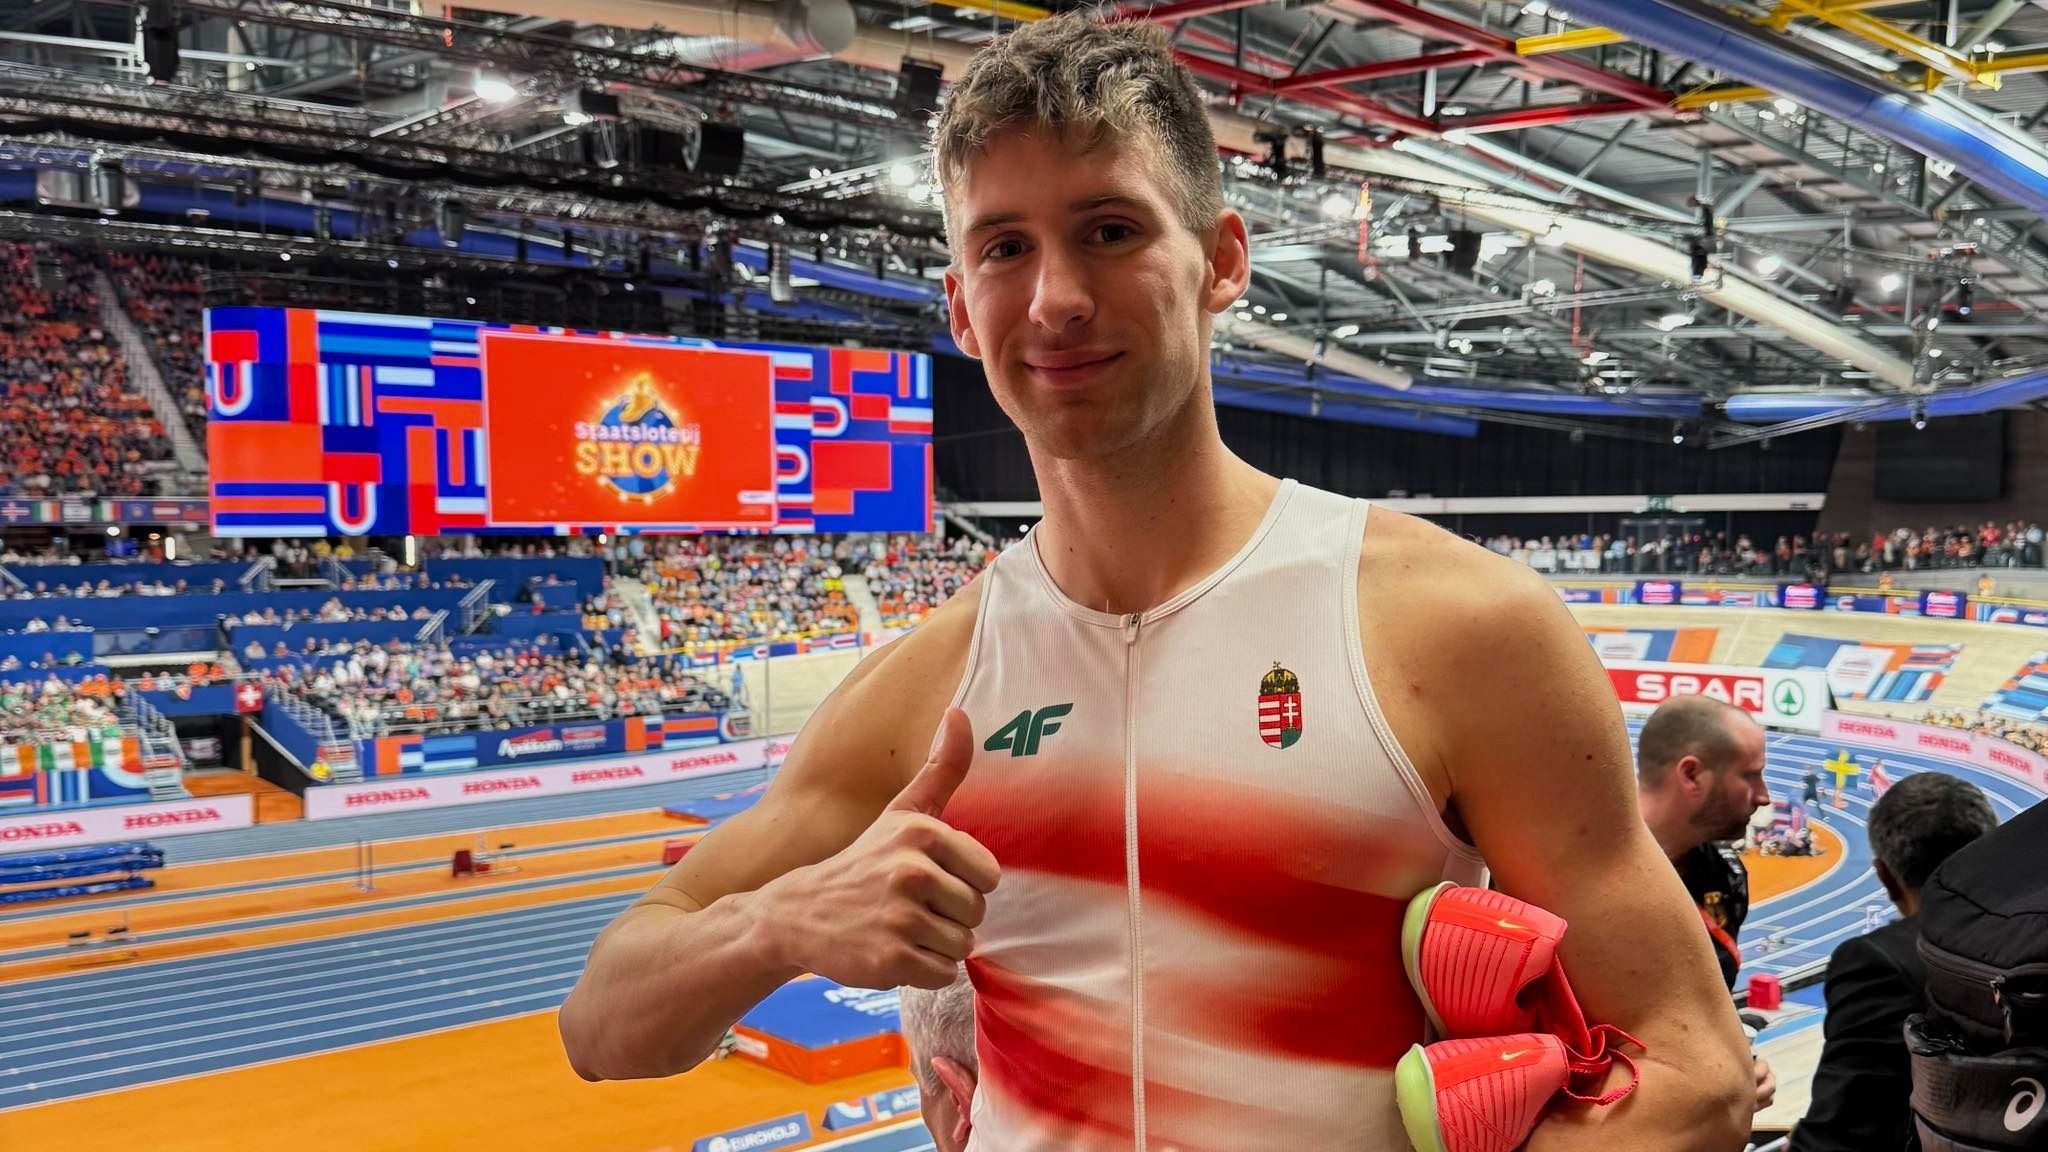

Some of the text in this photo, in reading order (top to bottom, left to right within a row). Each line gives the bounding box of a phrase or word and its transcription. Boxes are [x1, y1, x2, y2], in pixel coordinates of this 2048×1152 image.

[575, 441, 700, 478] SHOW
[1636, 673, 1762, 709] SPAR
[983, 702, 1074, 757] 4F
[1838, 720, 1895, 739] HONDA
[1918, 732, 1973, 752] HONDA
[670, 752, 737, 771] HONDA
[1988, 749, 2032, 772] HONDA
[571, 765, 643, 783] HONDA
[462, 776, 542, 795] HONDA
[345, 787, 430, 807] HONDA
[123, 807, 221, 830] HONDA
[0, 820, 84, 842] ONDA
